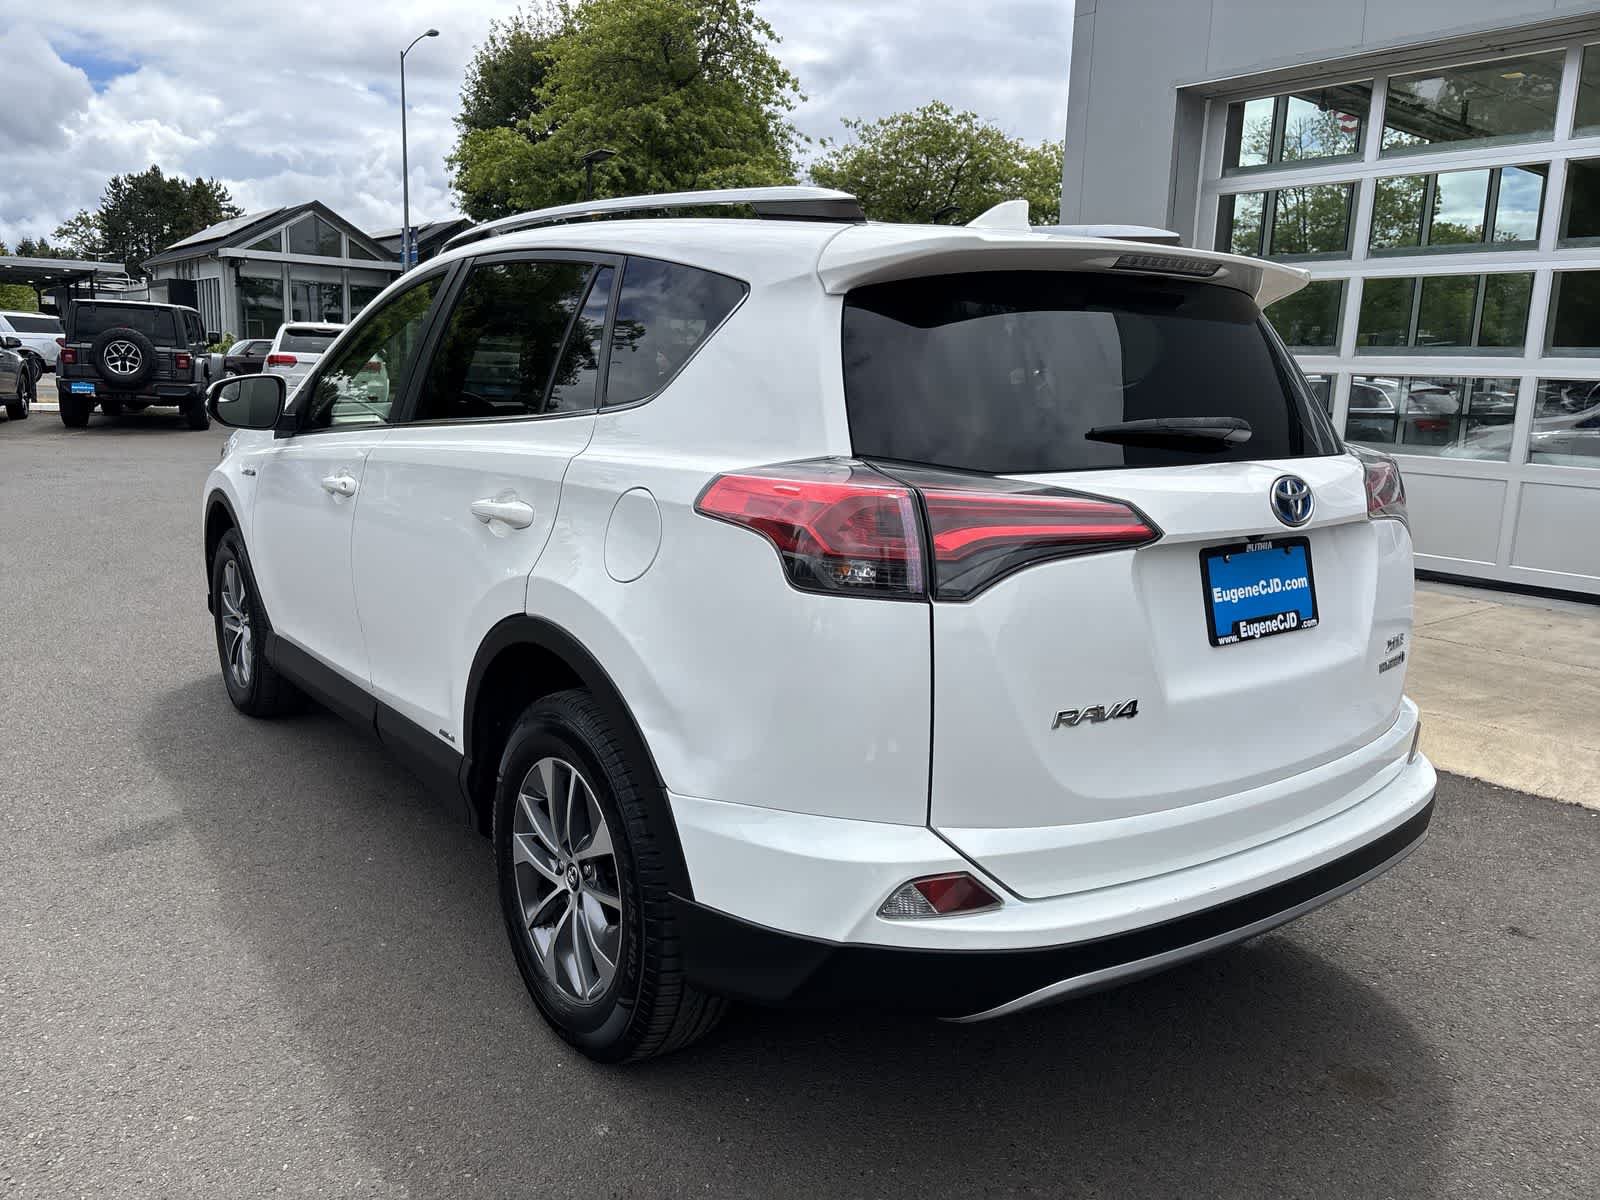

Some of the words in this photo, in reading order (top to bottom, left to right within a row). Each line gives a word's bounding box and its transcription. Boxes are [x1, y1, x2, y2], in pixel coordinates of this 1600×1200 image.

[1212, 576, 1308, 604] EugeneCJD.com
[1217, 634, 1240, 645] www.
[1239, 611, 1298, 638] EugeneCJD
[1051, 698, 1138, 730] RAV4
